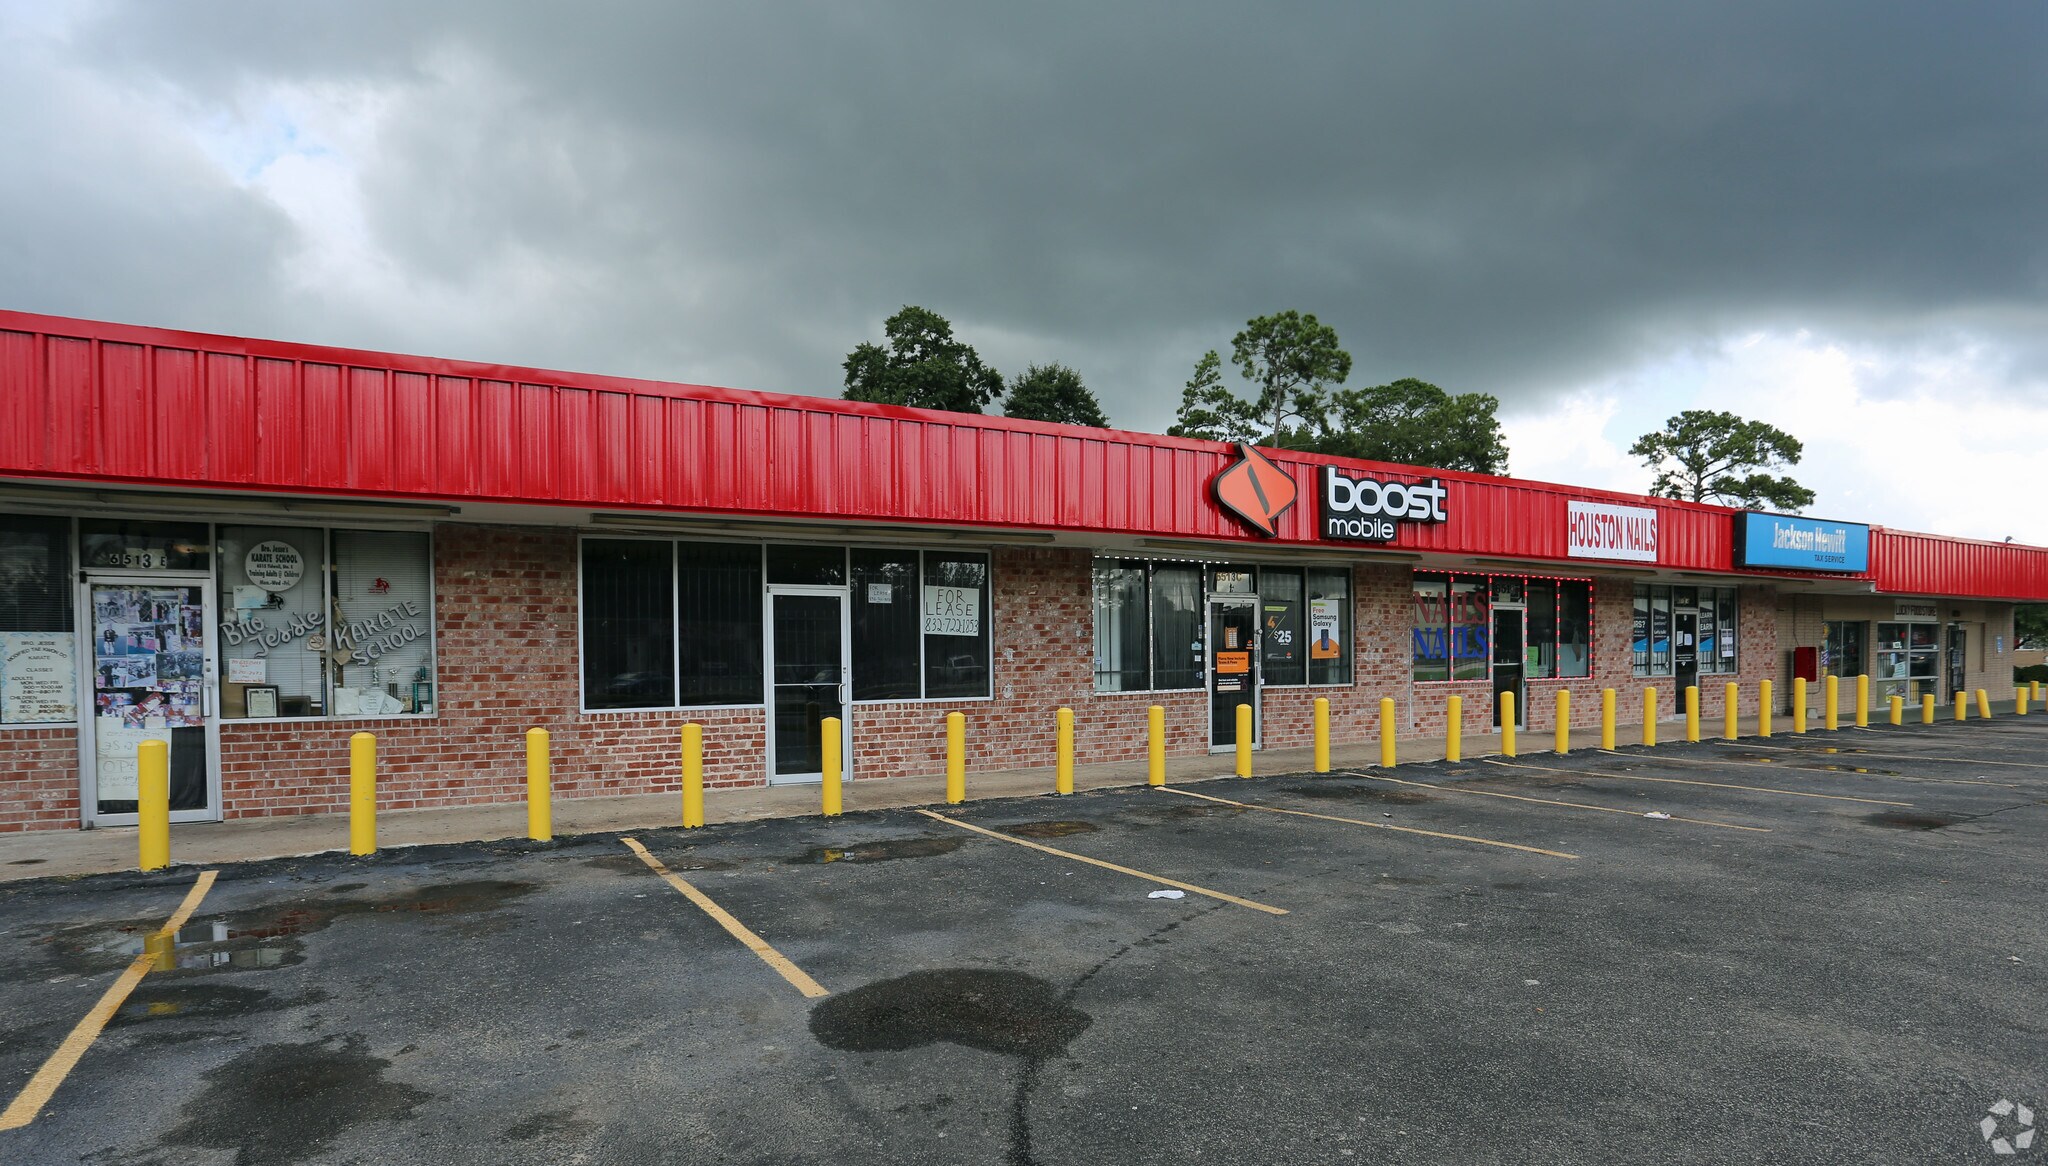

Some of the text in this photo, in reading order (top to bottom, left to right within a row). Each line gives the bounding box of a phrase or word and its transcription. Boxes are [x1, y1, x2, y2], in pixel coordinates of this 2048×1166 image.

[1328, 467, 1446, 521] boost
[1329, 517, 1395, 539] mobile
[1569, 511, 1656, 553] HOUSTON NAILS
[1773, 522, 1846, 554] Jackson Hewitt
[251, 553, 298, 564] KARATE SCHOOL
[1814, 554, 1846, 564] TAX SERVICE
[937, 589, 966, 603] FOR
[925, 602, 973, 616] LEASE
[1413, 591, 1488, 625] NAILS
[1699, 611, 1713, 619] LEARN
[333, 600, 422, 650] KARATE
[1267, 615, 1276, 629] 4
[1312, 614, 1337, 622] Samsung
[1633, 620, 1646, 629] IRS?
[1700, 623, 1713, 631] EARN
[1274, 630, 1292, 643] $25
[1413, 626, 1490, 660] NAILS
[351, 623, 427, 667] SCHOOL
